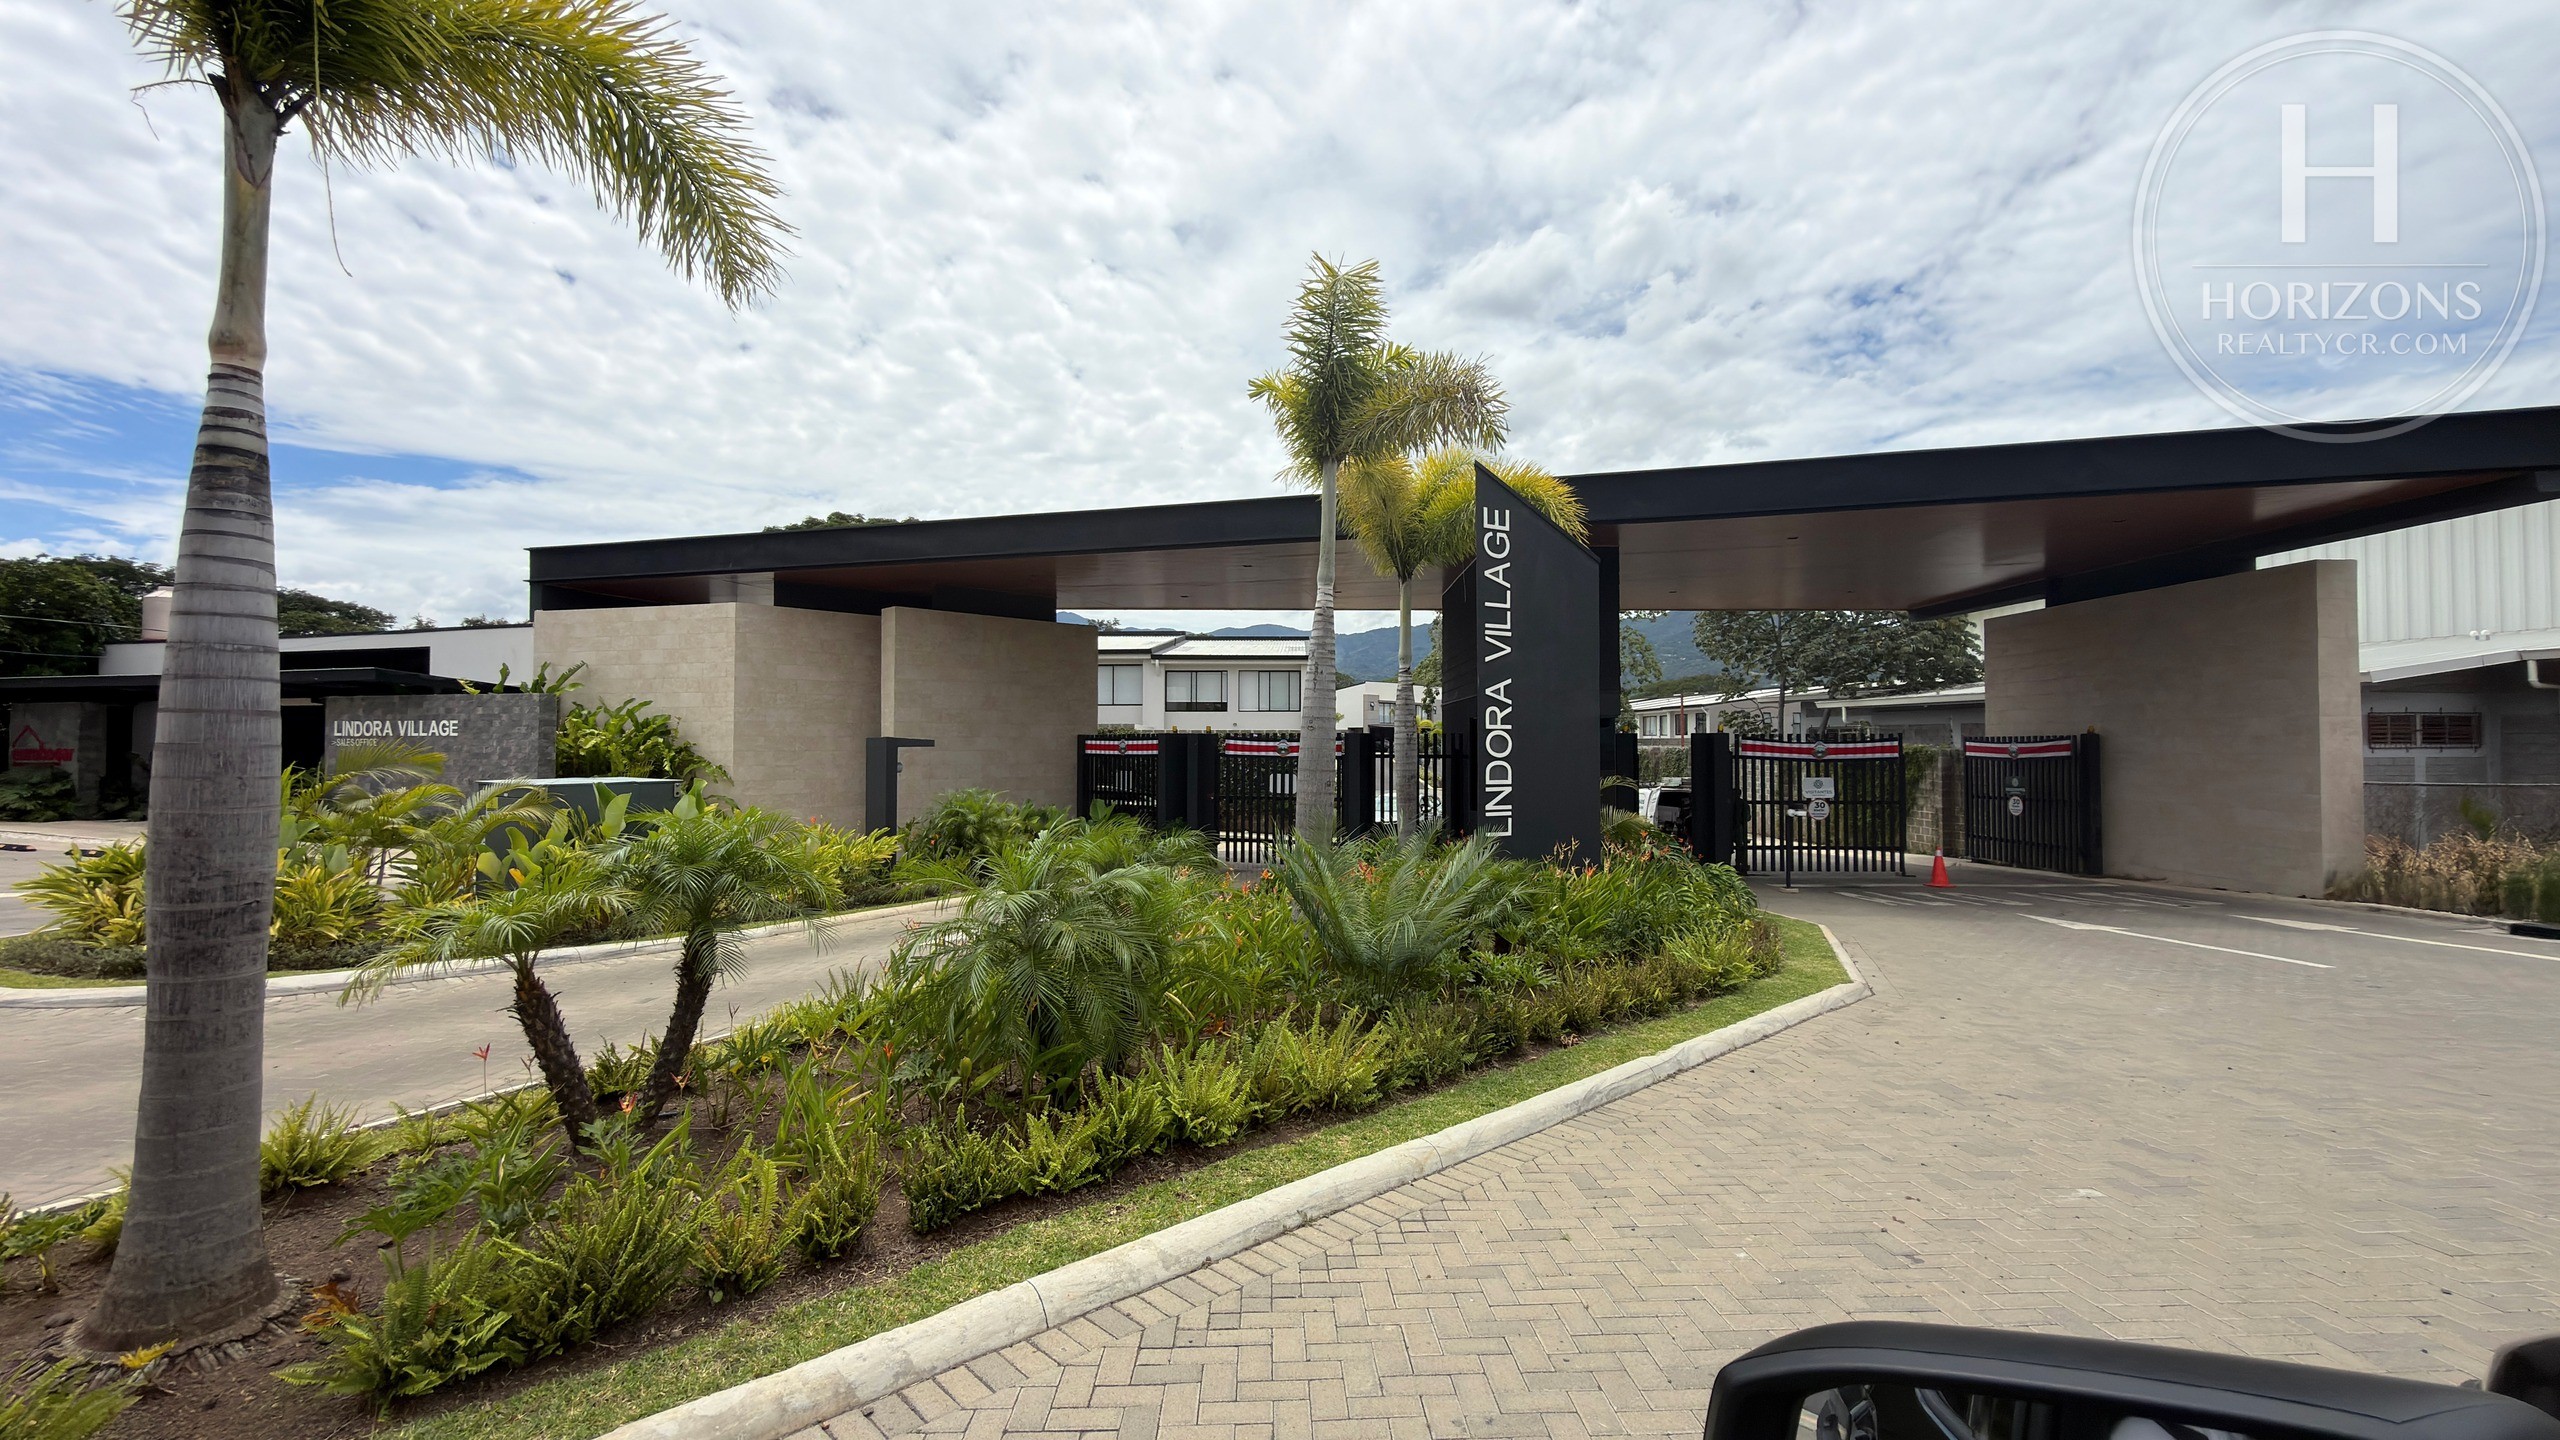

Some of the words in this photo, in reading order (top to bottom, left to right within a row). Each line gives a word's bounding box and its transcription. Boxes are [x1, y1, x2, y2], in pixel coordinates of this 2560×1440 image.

[1482, 506, 1512, 663] VILLAGE
[333, 720, 393, 737] LINDORA
[397, 719, 459, 737] VILLAGE
[1484, 677, 1513, 837] LINDORA
[1814, 801, 1826, 809] 30
